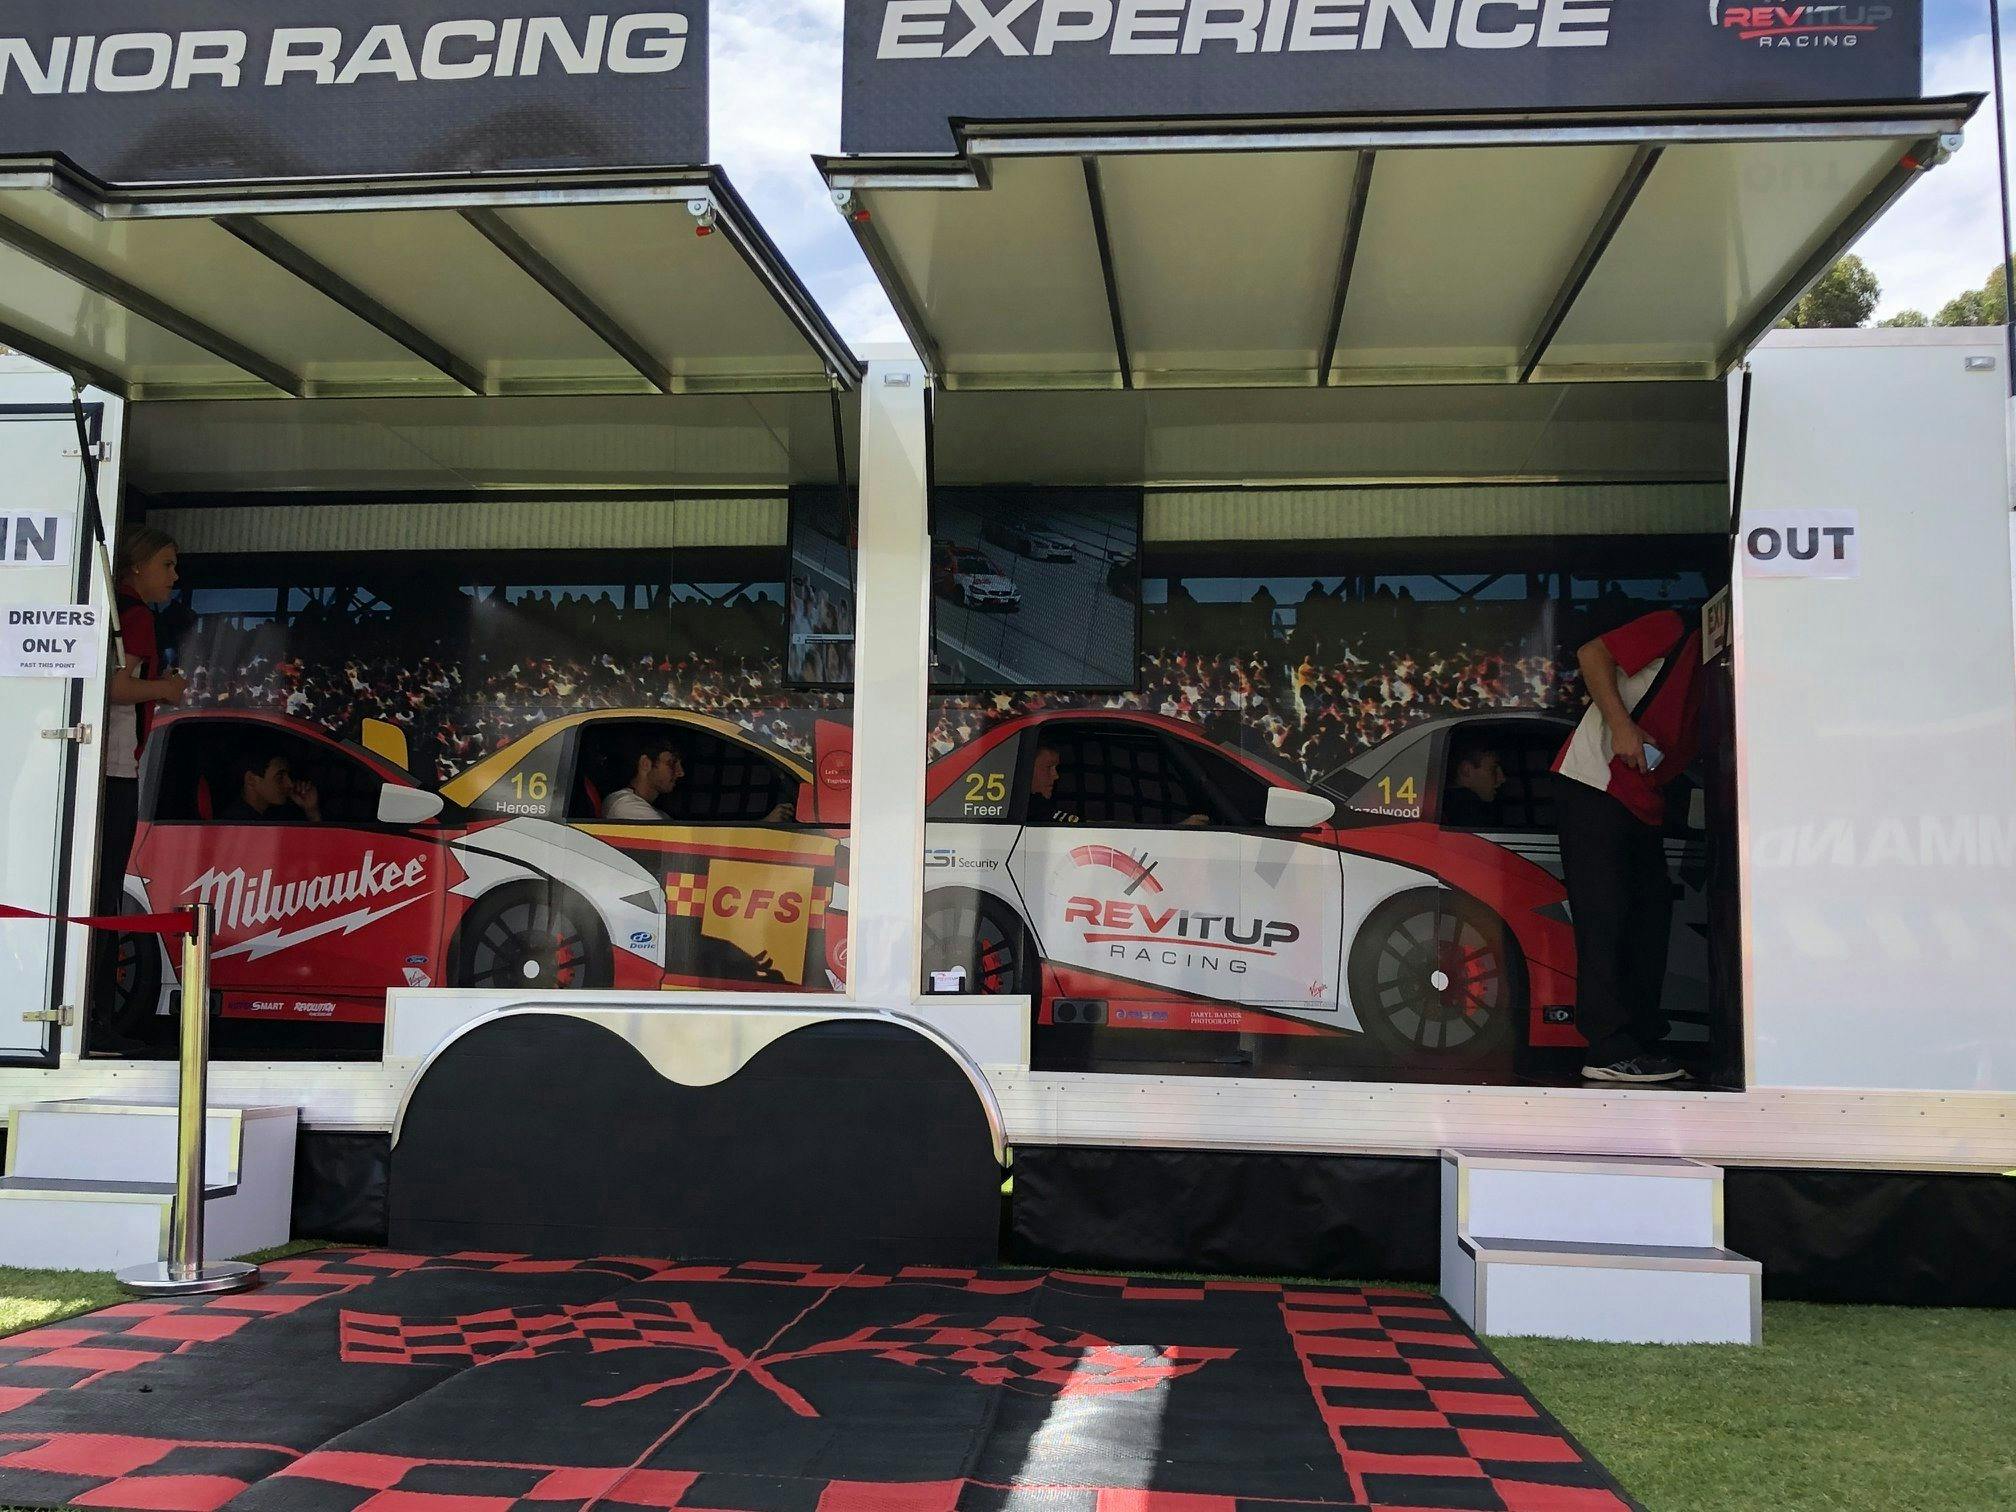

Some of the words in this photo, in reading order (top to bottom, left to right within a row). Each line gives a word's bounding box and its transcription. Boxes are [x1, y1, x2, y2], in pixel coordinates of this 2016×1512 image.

[876, 0, 1611, 60] EXPERIENCE
[1759, 34, 1858, 48] RACING
[0, 31, 247, 94] NIOR
[264, 13, 690, 87] RACING
[1746, 526, 1855, 561] OUT
[9, 610, 95, 626] DRIVERS
[22, 638, 77, 653] ONLY
[510, 772, 549, 800] 16
[965, 773, 1006, 802] 25
[1378, 776, 1418, 805] 14
[496, 801, 547, 815] Heroes
[963, 803, 1003, 817] Freer
[958, 857, 999, 871] Security
[711, 885, 803, 923] CFS
[1109, 944, 1248, 974] RACING
